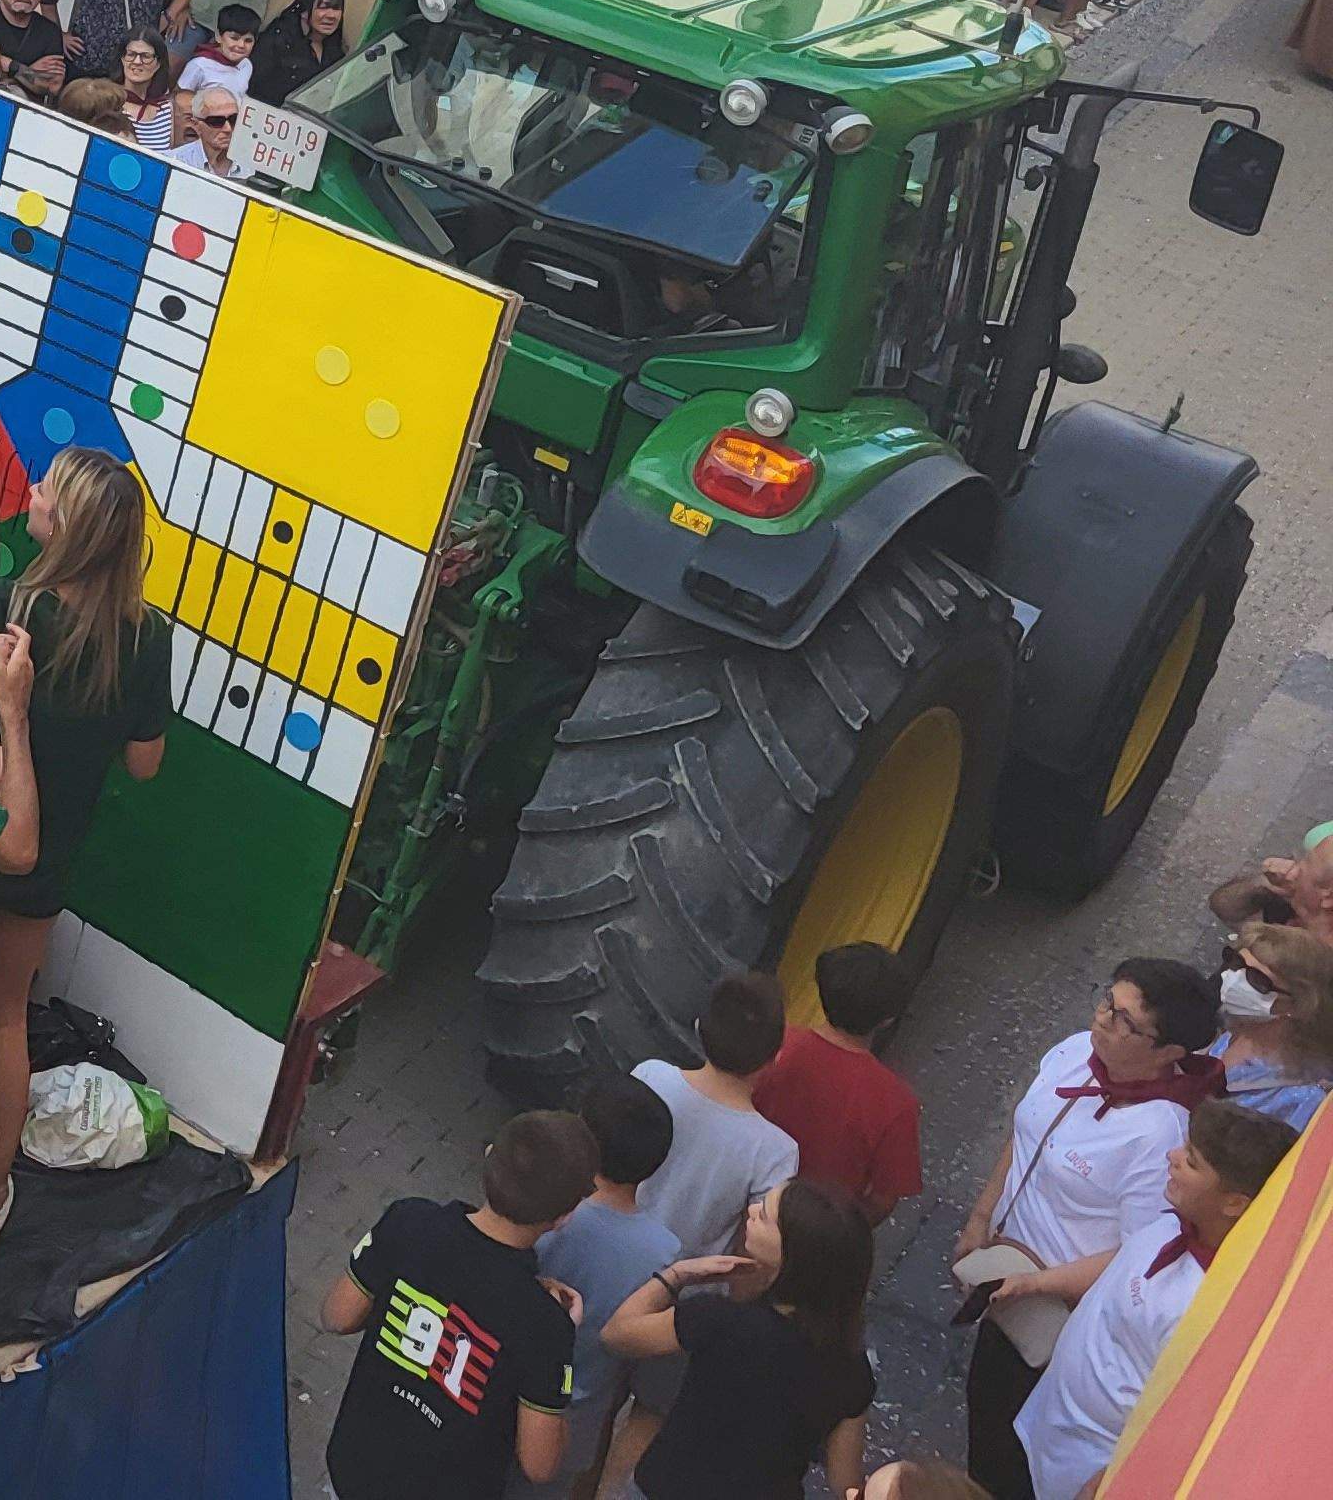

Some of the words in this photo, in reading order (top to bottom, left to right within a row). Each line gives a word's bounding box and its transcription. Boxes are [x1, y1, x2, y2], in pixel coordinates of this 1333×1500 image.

[242, 105, 256, 128] E
[263, 113, 318, 152] 5019
[253, 141, 295, 175] BFH
[400, 1302, 472, 1399] 91
[392, 1384, 420, 1409] GAME
[420, 1402, 444, 1429] SPIRIT
